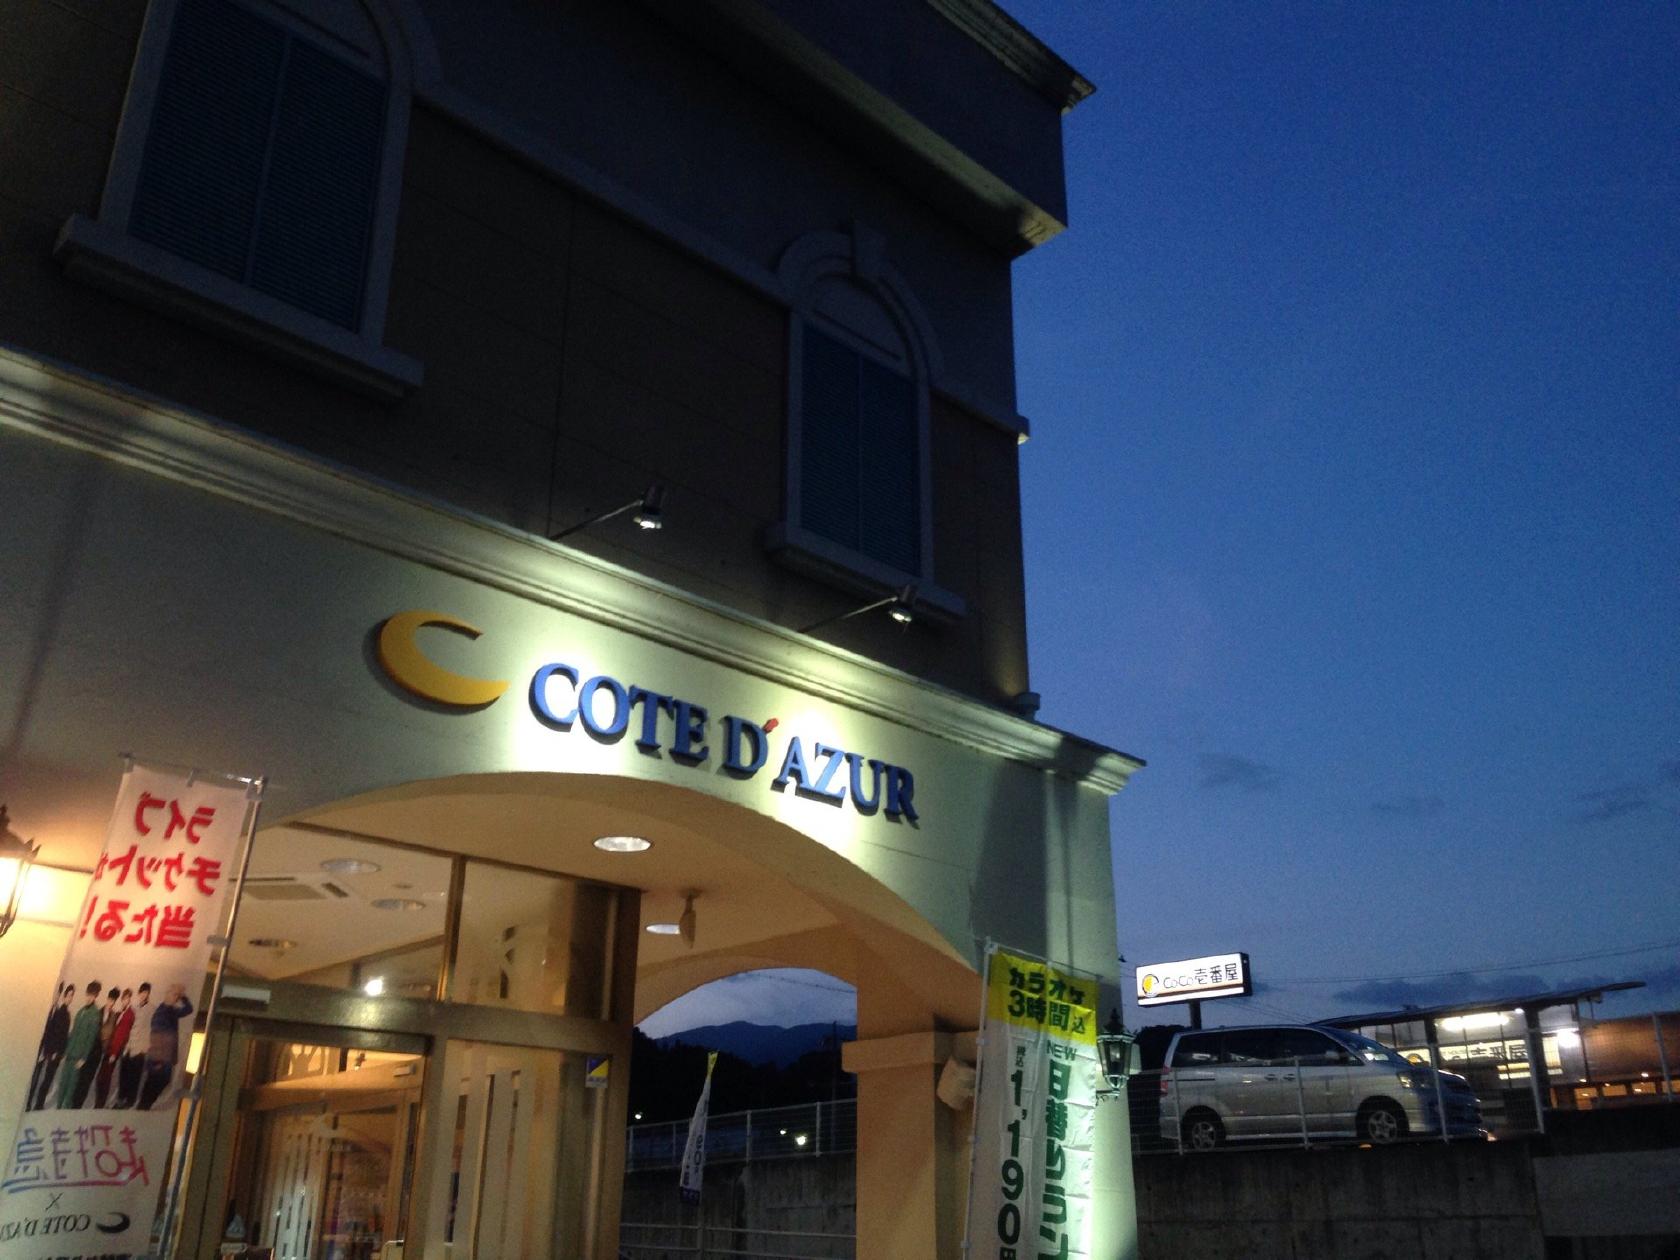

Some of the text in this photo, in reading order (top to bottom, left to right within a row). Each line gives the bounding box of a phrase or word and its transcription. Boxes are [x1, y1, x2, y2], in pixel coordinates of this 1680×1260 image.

[528, 662, 709, 767] COTE
[1009, 967, 1086, 1005] カラオケ
[1047, 1040, 1078, 1061] NEW
